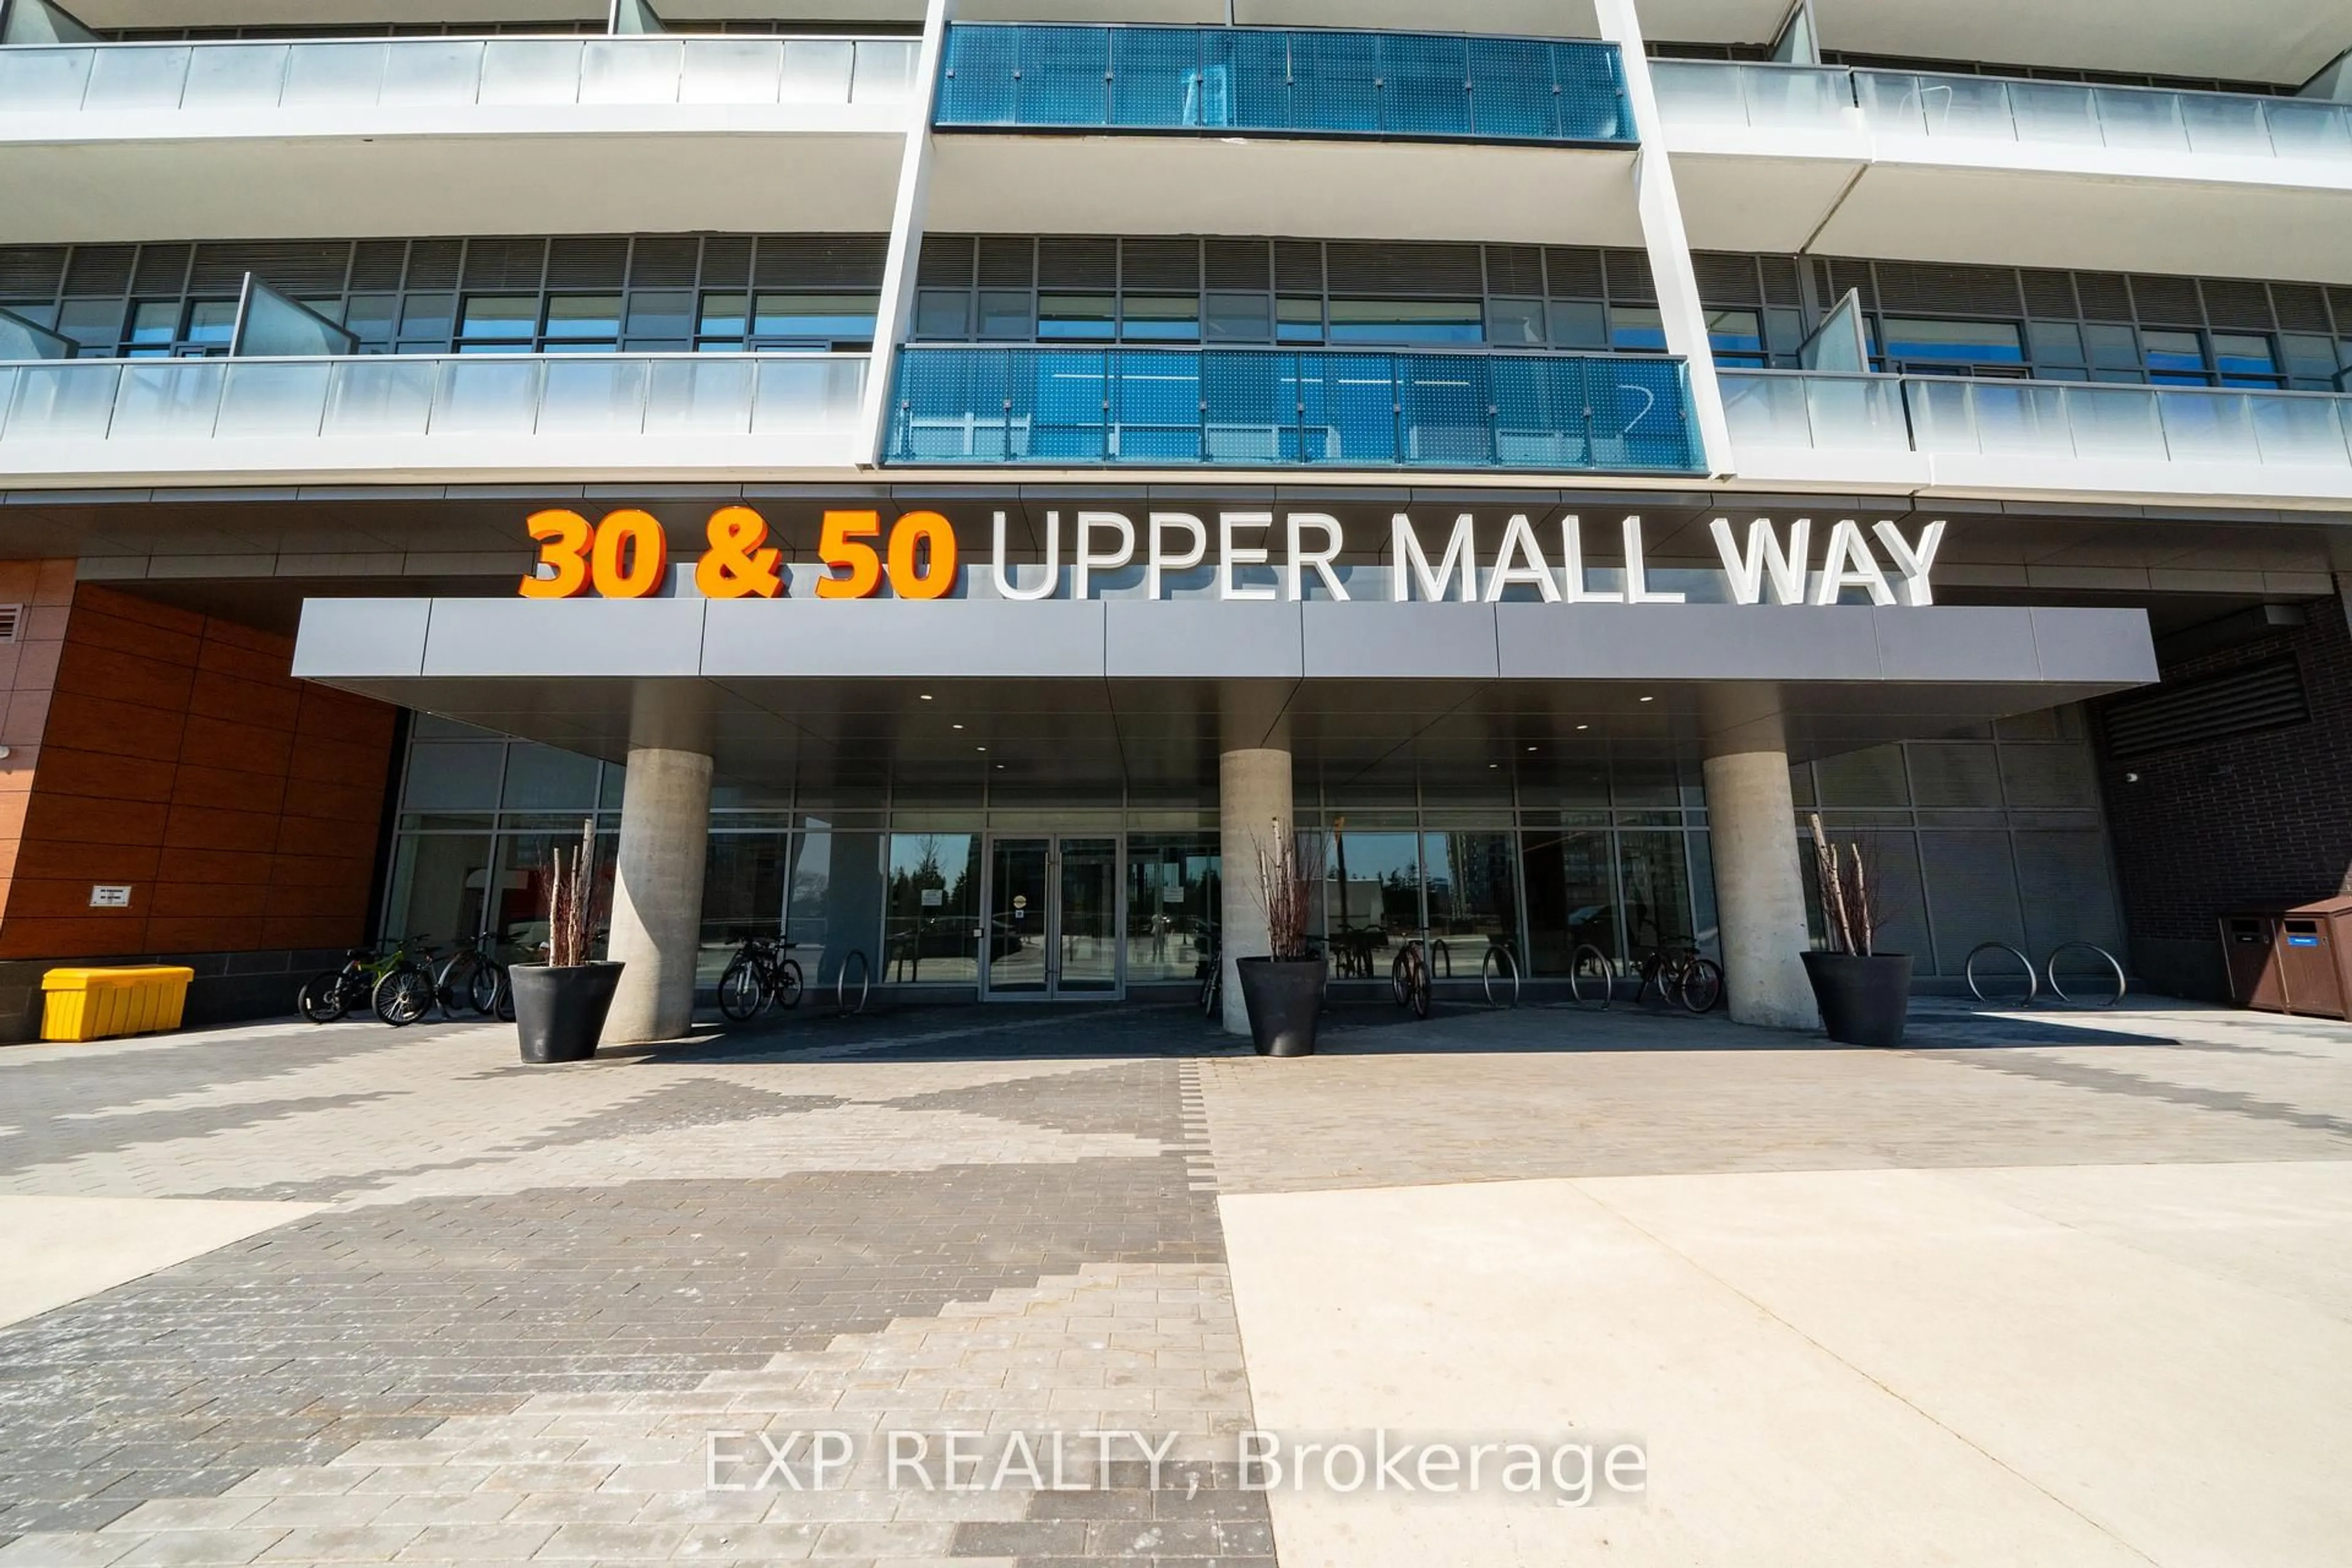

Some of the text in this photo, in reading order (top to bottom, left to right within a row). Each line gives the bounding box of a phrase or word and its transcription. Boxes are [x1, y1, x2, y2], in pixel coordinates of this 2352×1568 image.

[518, 506, 1947, 606] 30 & 50 UPPER MALL WAY
